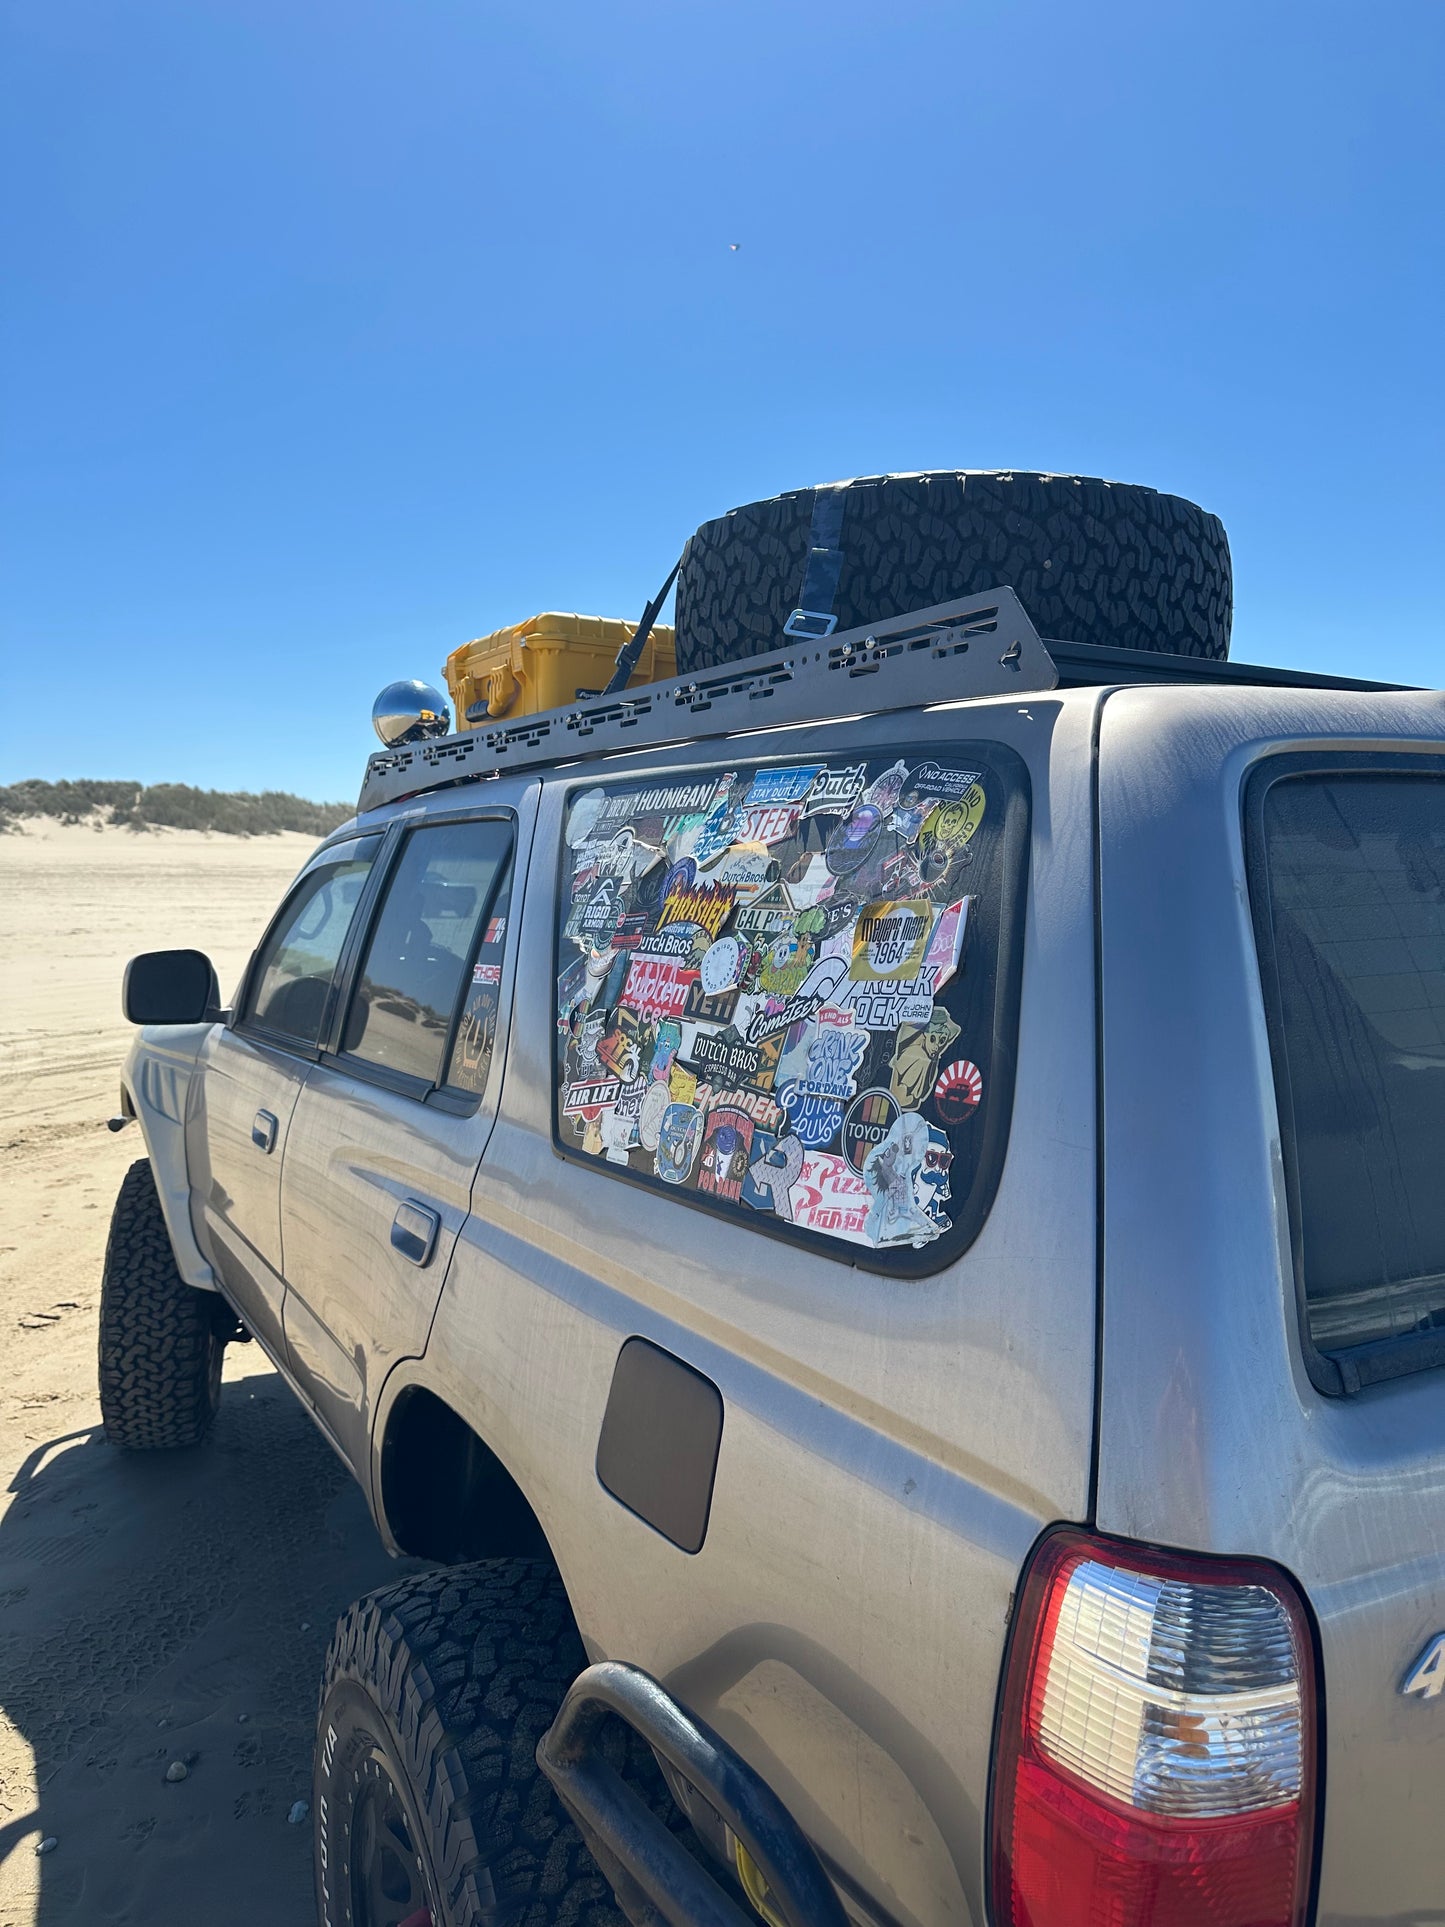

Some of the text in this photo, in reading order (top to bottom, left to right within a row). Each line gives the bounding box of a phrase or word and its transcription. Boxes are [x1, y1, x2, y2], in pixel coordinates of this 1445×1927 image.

[926, 769, 978, 784] NO ACCESS
[751, 783, 801, 799] STAY DUTCH
[721, 871, 747, 883] DUTCH
[574, 893, 591, 903] TOYOT
[584, 905, 611, 919] RIGID
[582, 918, 605, 928] ARMOR
[736, 910, 762, 931] CAL
[663, 935, 694, 955] BROS
[873, 941, 906, 965] 1964
[901, 1011, 930, 1019] CURRIE
[695, 1037, 759, 1073] DUTCH BROS
[568, 1084, 619, 1106] AIR LIFT
[848, 1122, 890, 1142] TOYOT
